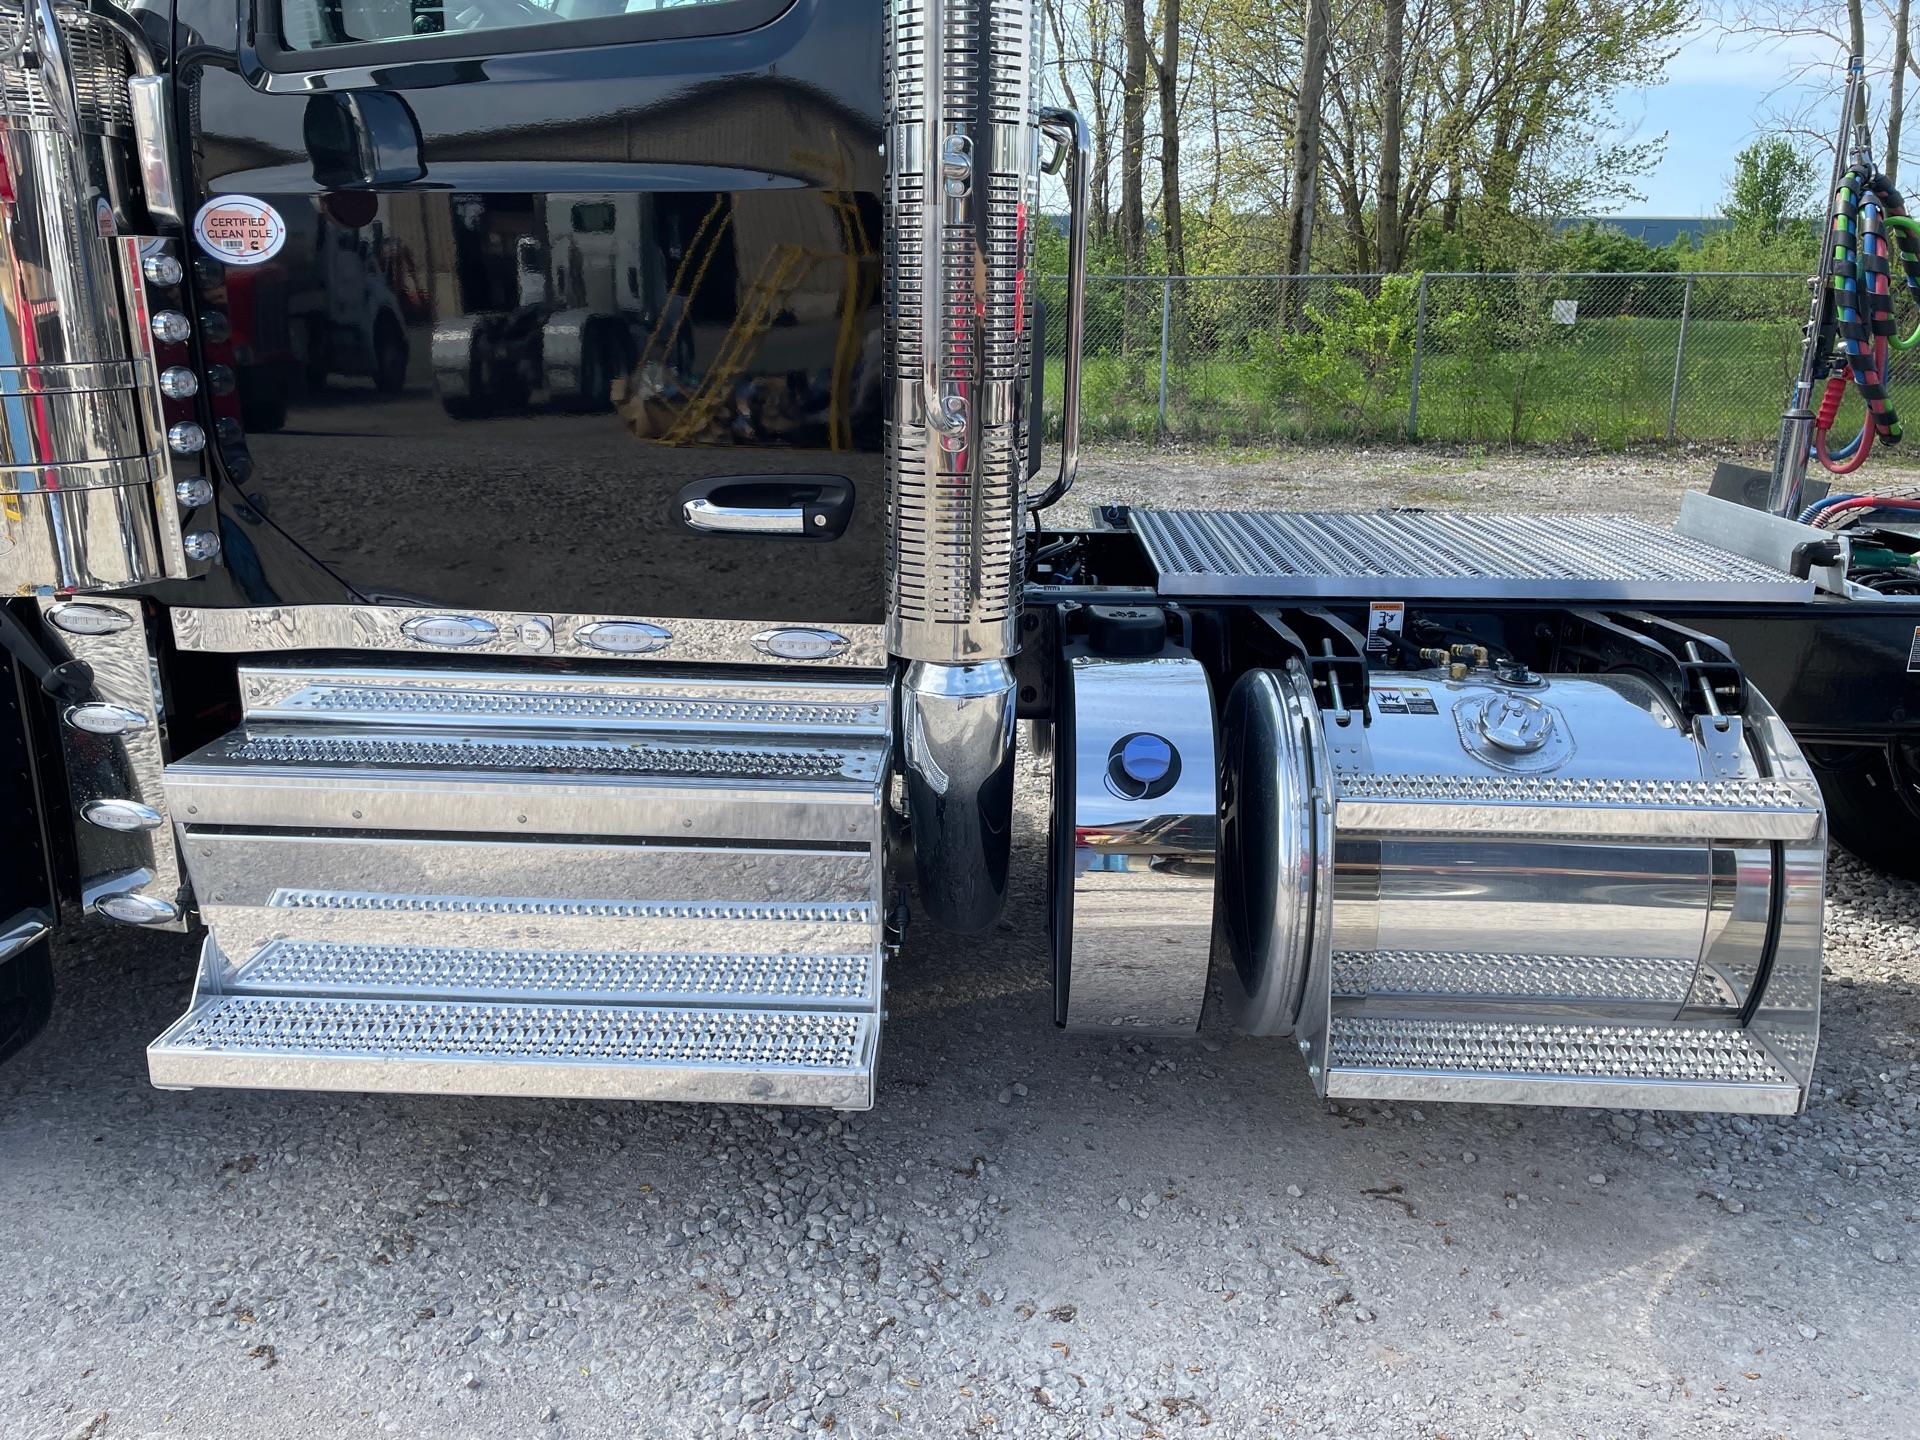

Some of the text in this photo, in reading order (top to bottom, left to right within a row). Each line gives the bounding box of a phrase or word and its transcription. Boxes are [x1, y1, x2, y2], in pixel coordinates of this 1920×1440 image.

[210, 217, 266, 227] CERTIFIED
[207, 229, 273, 239] CLEAN IDLE
